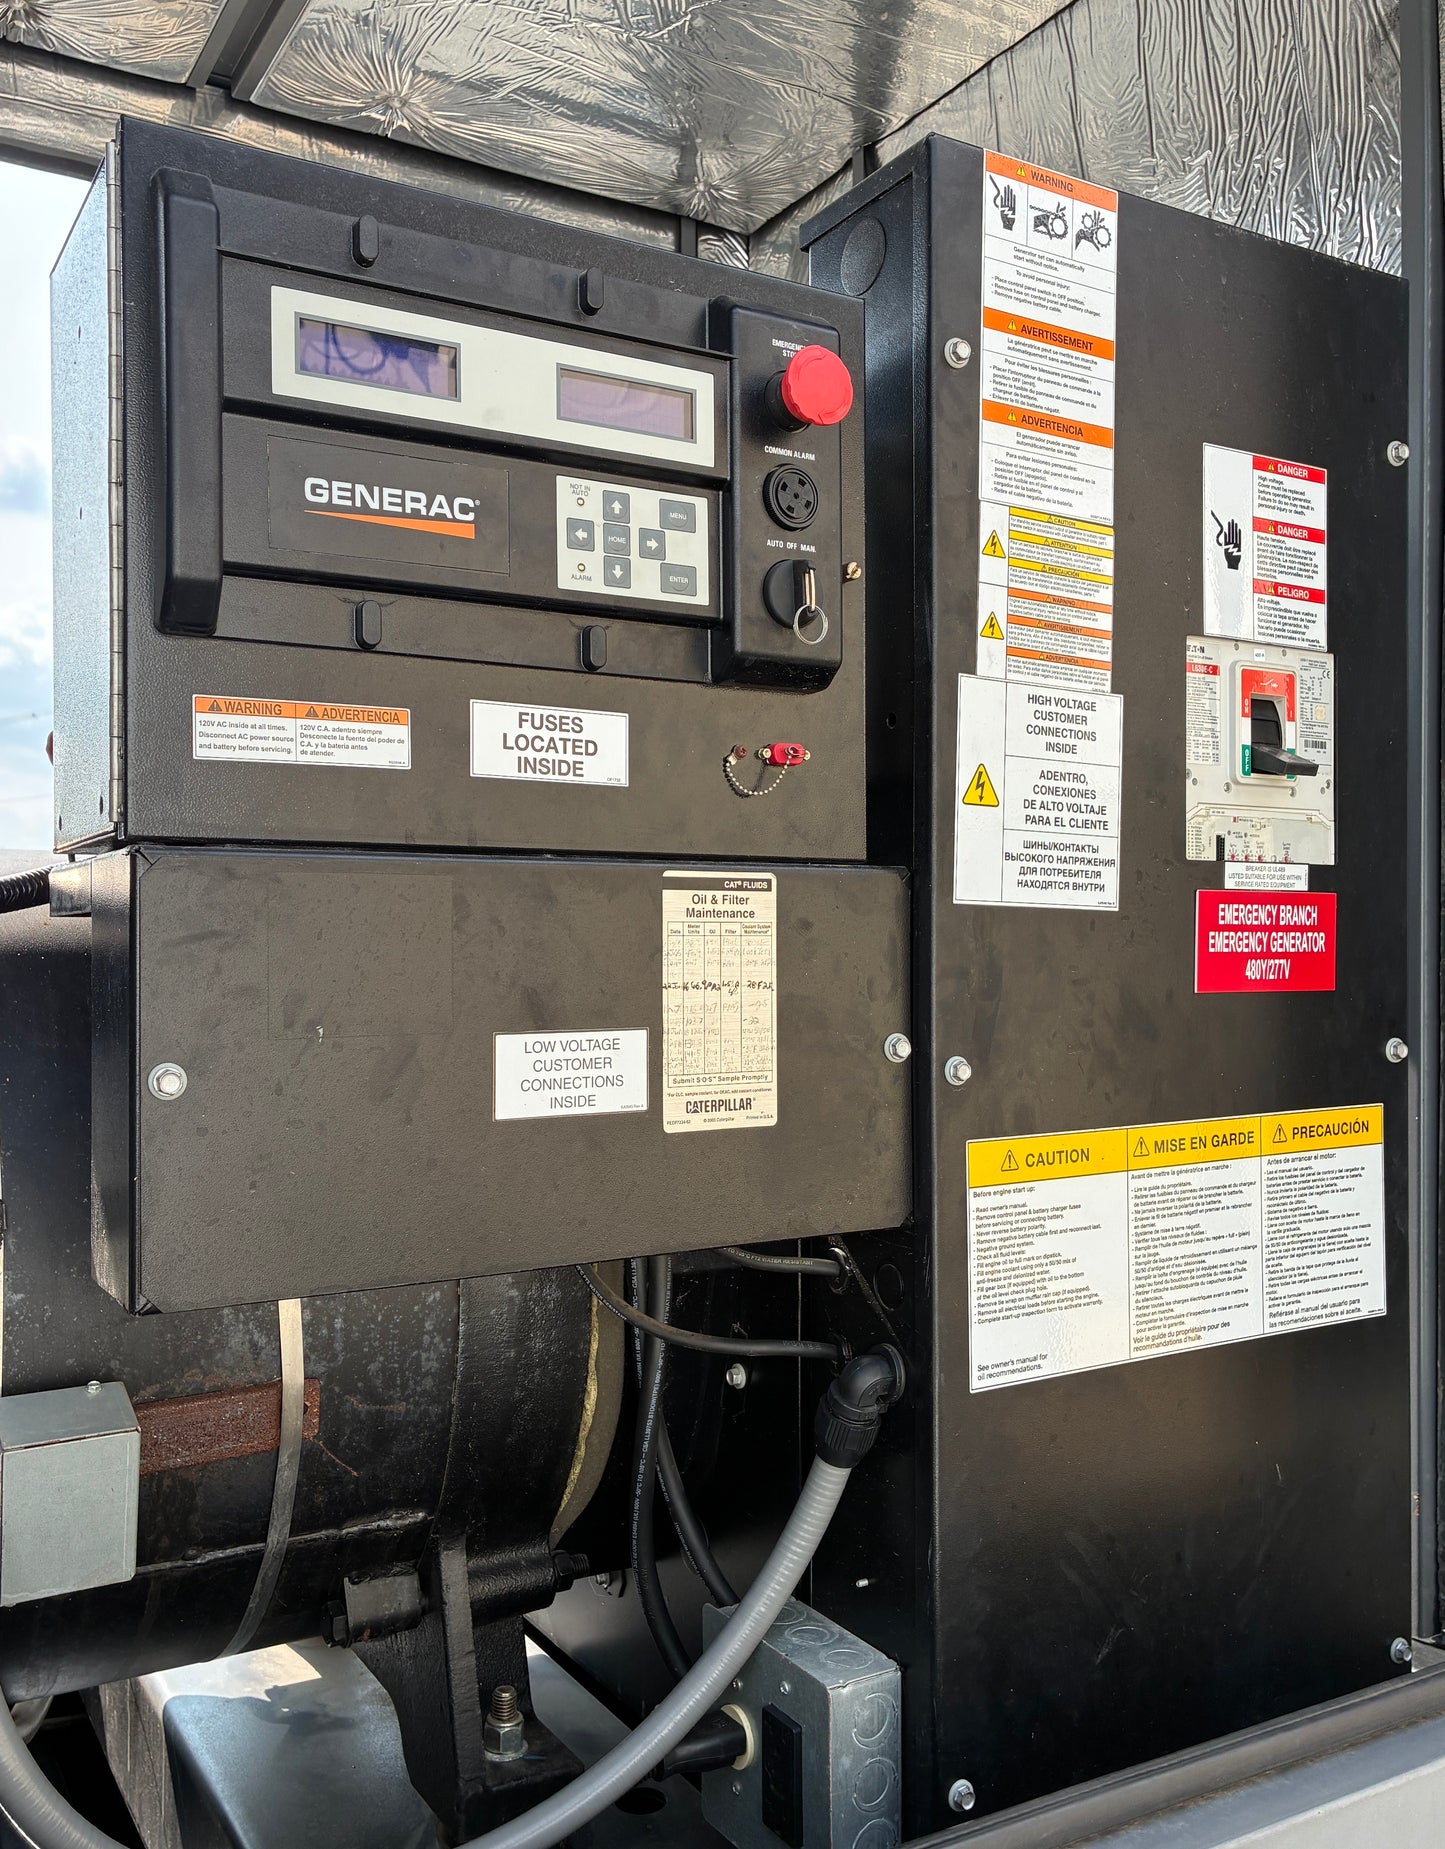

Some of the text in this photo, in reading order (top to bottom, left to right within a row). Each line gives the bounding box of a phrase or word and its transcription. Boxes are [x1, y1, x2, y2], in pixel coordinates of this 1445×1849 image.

[1031, 170, 1073, 192] WARNING
[1021, 325, 1093, 351] AVERTISSEMENT
[783, 350, 796, 358] STO
[1021, 415, 1083, 437] ADVERTENCIA
[765, 446, 815, 460] COMMON ALARM
[1278, 464, 1308, 478] DANGER
[1054, 518, 1076, 527] CAUTION
[1278, 525, 1308, 538] DANGER
[767, 539, 783, 548] AUTO
[801, 544, 816, 553] MAN.
[1051, 540, 1077, 550] ATTENTION
[1048, 566, 1079, 578] PRECAUCIÓN
[1278, 586, 1309, 600] PELIGRO
[1052, 597, 1075, 606] WARNING
[1044, 623, 1082, 633] AVERTISSEMENT
[1046, 655, 1078, 664] ADVERTENCIA
[225, 701, 282, 715] WARNING
[1028, 694, 1097, 712] HIGH VOLTAGE
[1245, 698, 1248, 714] ON
[322, 708, 400, 723] ADVERTENCIA
[518, 712, 583, 733] FUSES
[1034, 710, 1088, 725] CUSTOMER
[198, 730, 236, 739] Disconnect
[357, 728, 382, 736] siempre
[1026, 724, 1097, 741] CONNECTIONS
[213, 742, 236, 751] battery
[261, 745, 293, 754] servicing.
[503, 733, 598, 756] LOCATED
[1046, 742, 1078, 754] INSIDE
[518, 756, 584, 777] INSIDE
[1039, 770, 1088, 785] ADENTRO,
[1033, 784, 1096, 799] CONEXIONES
[1024, 799, 1107, 815] DE ALTO VOLTAJE
[1025, 815, 1109, 830] PARA EL CLIENTE
[1023, 840, 1099, 854] ШИНЫ/КОНТАКТЫ
[1005, 852, 1115, 867] ВЫСОКОГО НАПРЯЖЕНИЯ
[1019, 867, 1102, 879] ДЛЯ ПОТРЕБИТЕЛЯ
[1017, 879, 1105, 892] НАХОДЯТСЯ ВНУТРИ
[692, 894, 750, 905] Oil & Filter
[686, 908, 755, 918] Maintenance
[1218, 904, 1317, 926] EMERGENCY BRANCH
[1208, 931, 1325, 953] EMERGENCY GENERATOR
[1246, 959, 1291, 980] 480Y/277V
[524, 1038, 620, 1054] LOW VOLTAGE
[533, 1057, 612, 1072] CUSTOMER
[520, 1074, 624, 1092] CONNECTIONS
[673, 1076, 694, 1084] Submit
[550, 1095, 596, 1109] INSIDE
[686, 1098, 752, 1113] CATERPILLAR
[1292, 1118, 1369, 1140] PRECAUCIÓN
[1154, 1131, 1254, 1154] MISE EN GARDE
[1025, 1148, 1090, 1168] CAUTION
[1176, 1166, 1203, 1176] génératrice
[973, 1190, 991, 1198] Before
[992, 1188, 1011, 1197] engine
[977, 1352, 1047, 1372] See owner's manual for
[986, 1362, 1042, 1379] recommendations.
